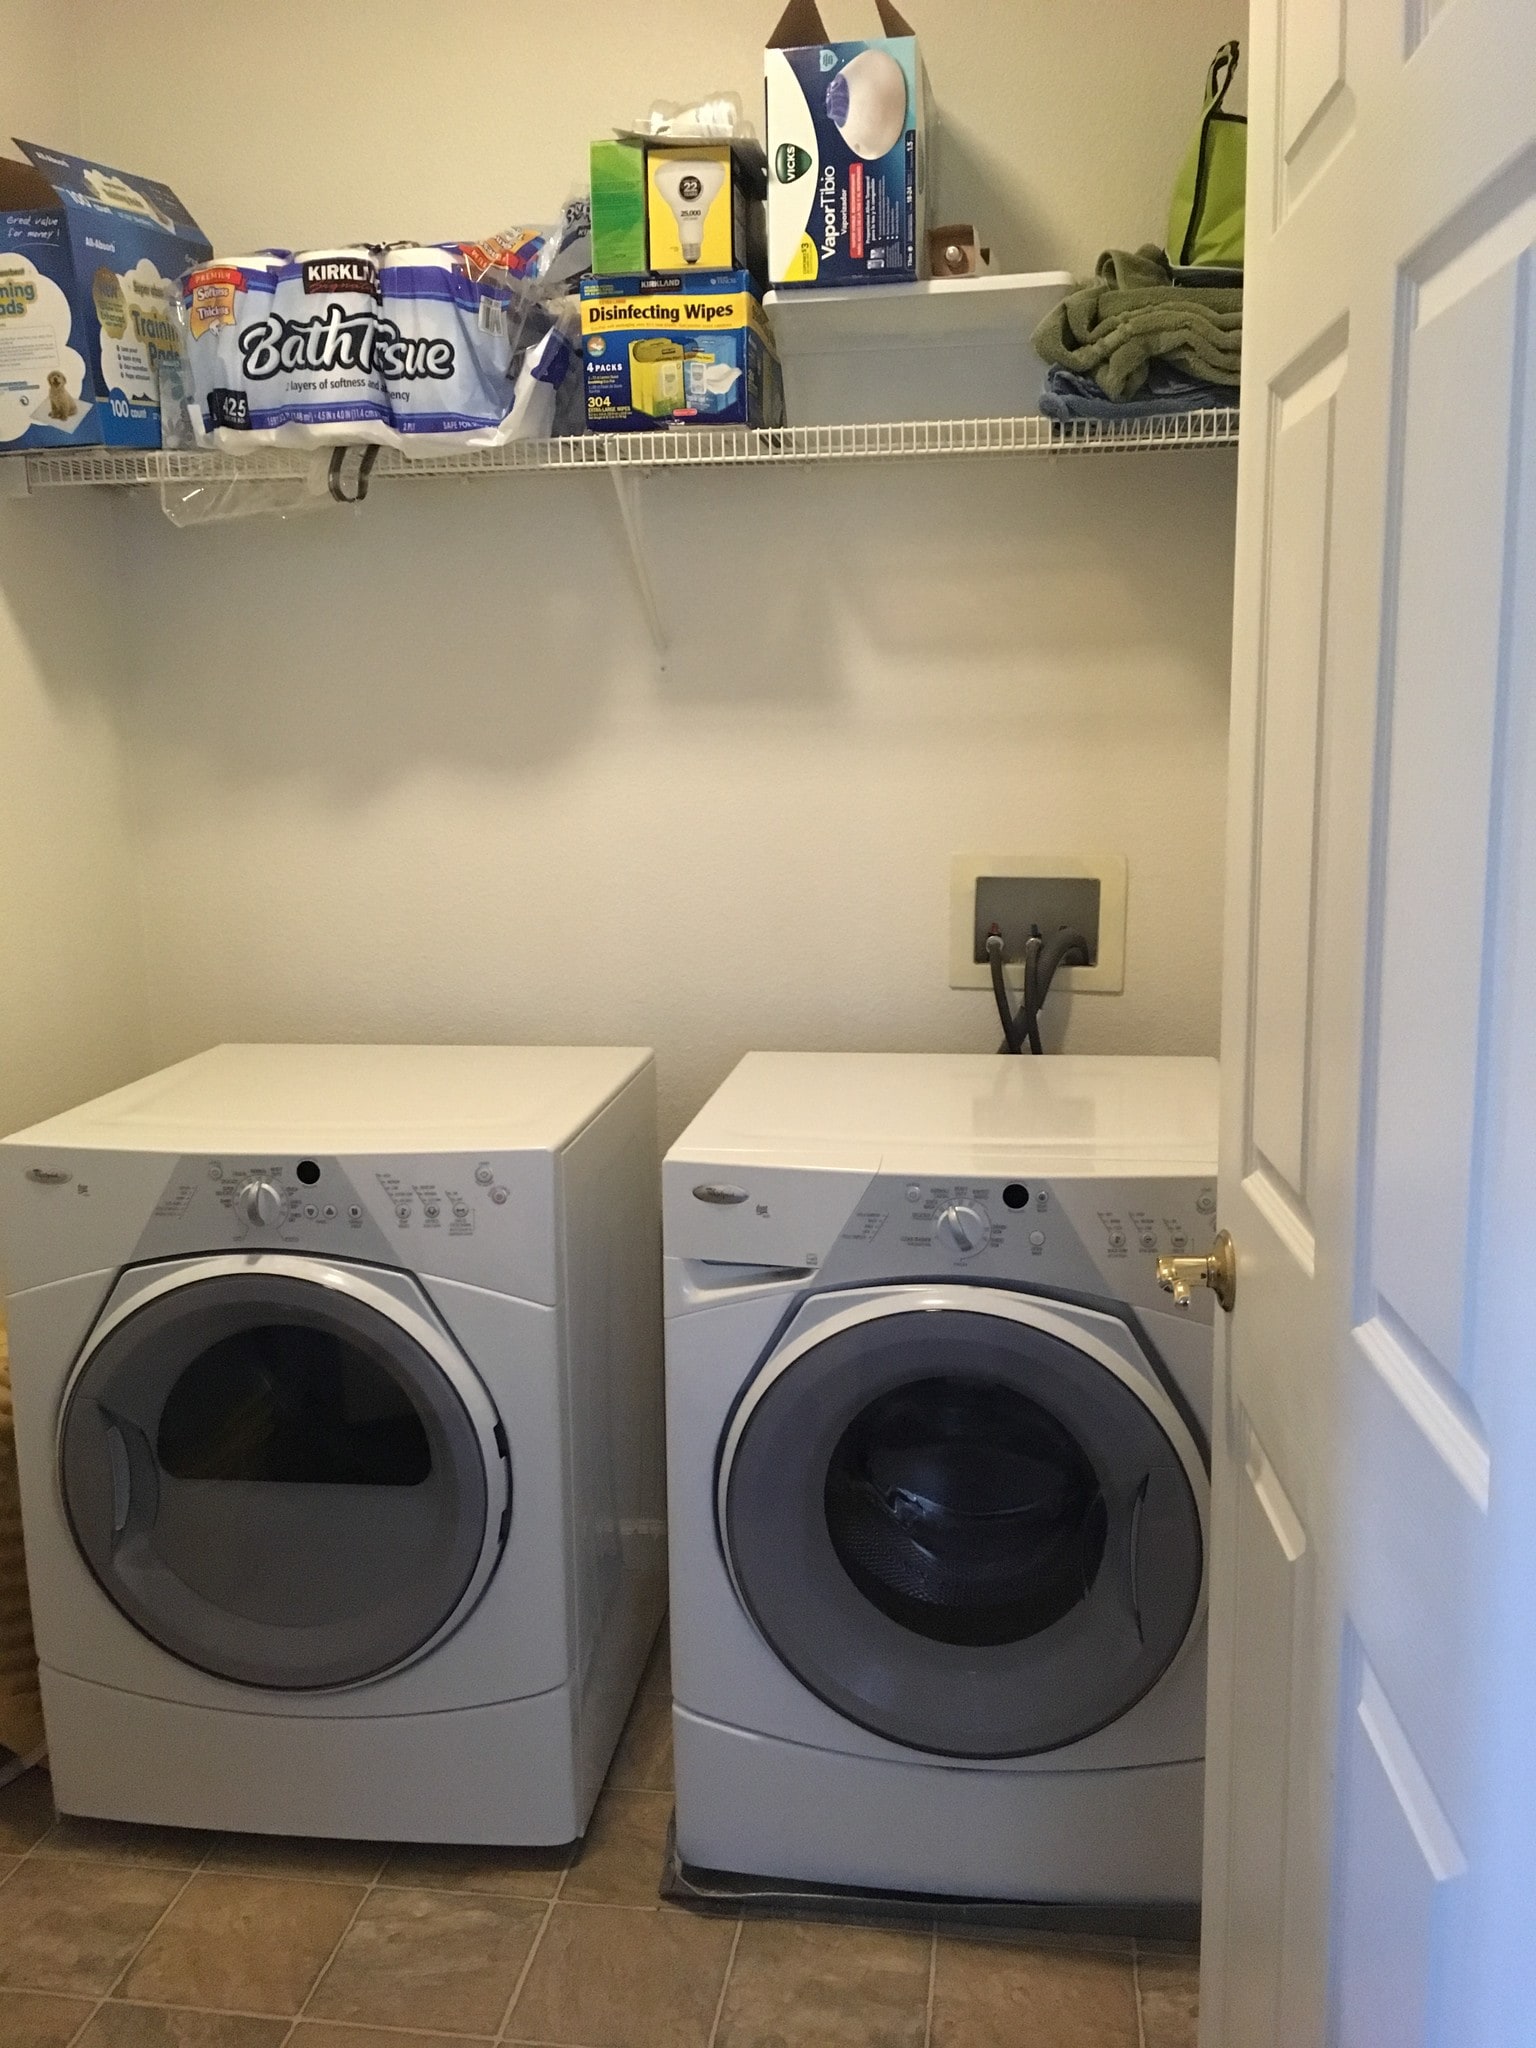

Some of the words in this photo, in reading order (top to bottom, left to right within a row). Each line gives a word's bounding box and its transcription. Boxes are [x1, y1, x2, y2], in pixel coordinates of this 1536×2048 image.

[787, 146, 796, 181] VICKS
[683, 182, 698, 192] 22
[840, 188, 849, 235] Vaporizador
[6, 215, 32, 226] Great
[35, 216, 59, 227] value
[8, 227, 23, 239] for
[307, 262, 374, 283] KIRKL
[589, 304, 680, 323] Disinfecting
[684, 303, 734, 322] Wipes
[240, 304, 354, 380] Bath
[348, 313, 455, 380] Tsue
[586, 362, 594, 373] 4
[595, 362, 623, 372] PACKS
[290, 377, 318, 391] layers
[318, 378, 328, 389] of
[330, 377, 366, 389] softness
[368, 380, 379, 390] and
[110, 399, 129, 418] 100
[130, 407, 147, 419] count
[587, 395, 611, 408] 304
